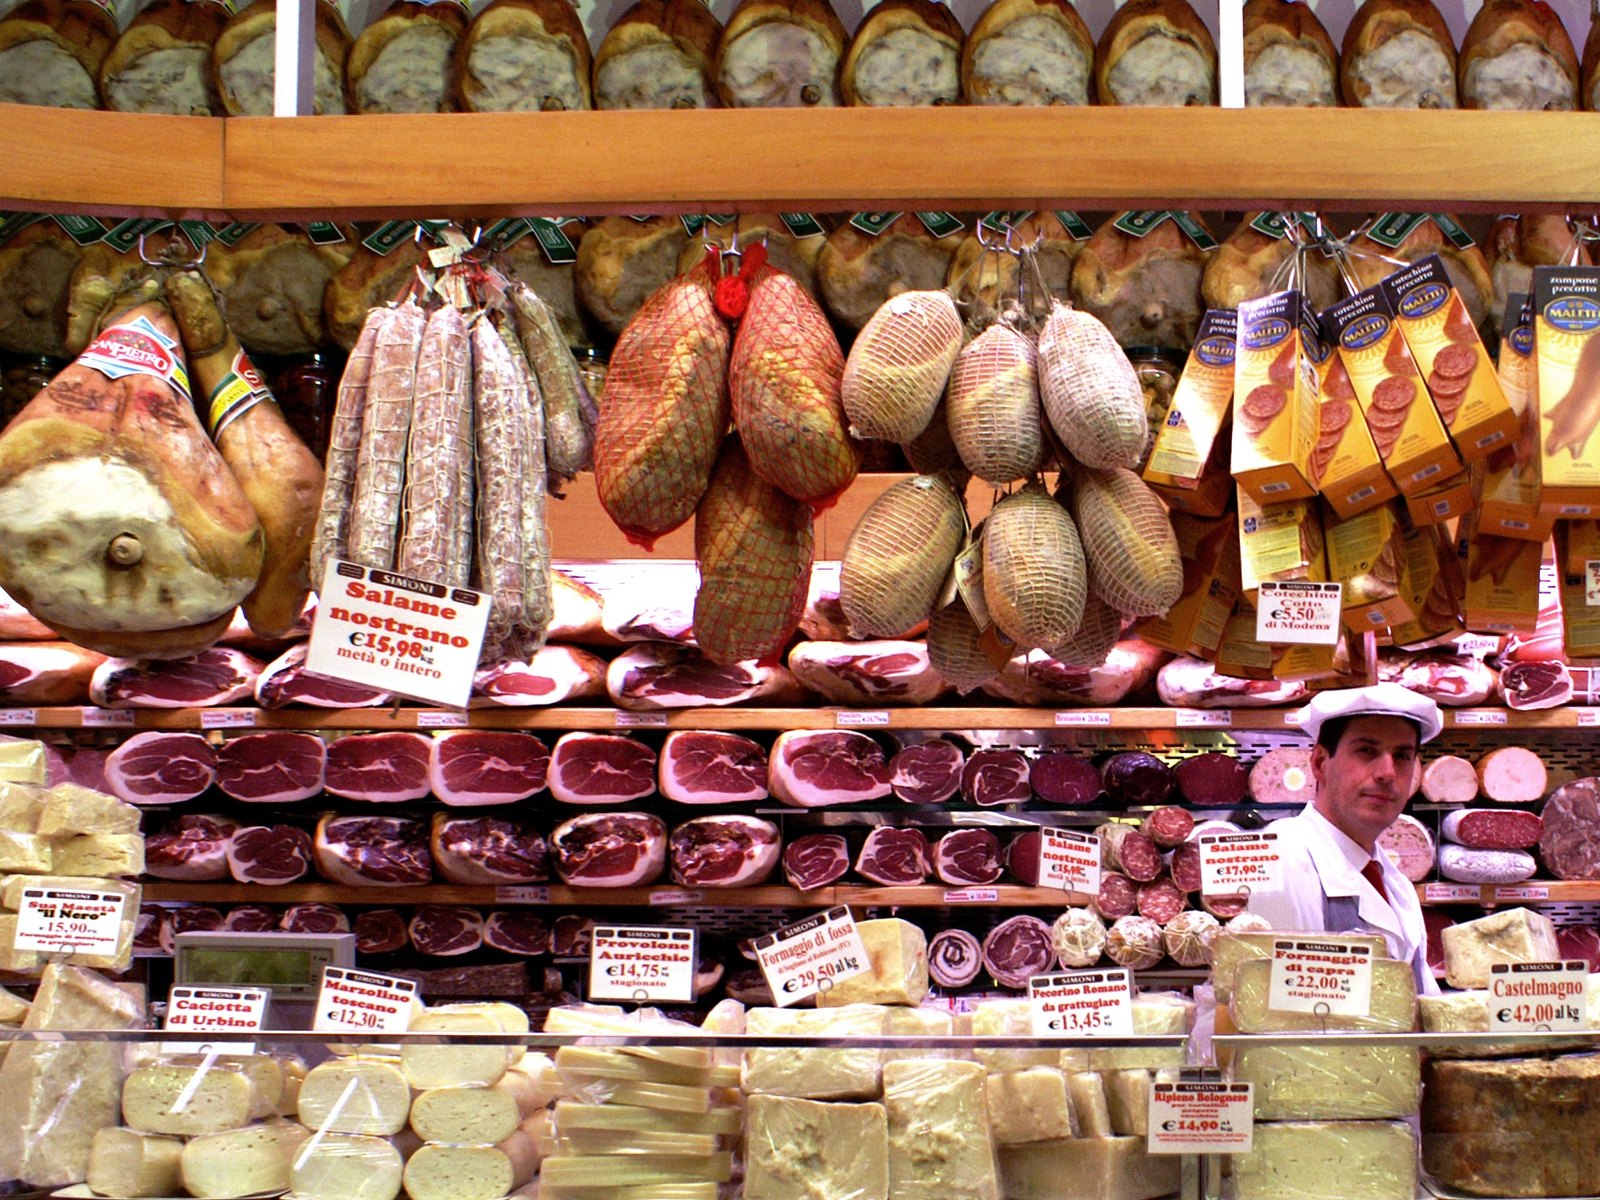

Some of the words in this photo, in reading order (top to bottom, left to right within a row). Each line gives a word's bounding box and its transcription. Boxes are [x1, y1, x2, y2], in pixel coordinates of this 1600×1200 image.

[1390, 263, 1433, 288] cotechino
[1396, 270, 1434, 295] precotto
[1550, 277, 1599, 287] zampone
[1552, 285, 1597, 295] precotto
[1333, 293, 1375, 318] cotechino
[1403, 287, 1445, 312] MALETTI
[1338, 301, 1375, 326] precotto
[1211, 317, 1237, 327] cotech
[1344, 319, 1386, 342] MALETTI
[383, 574, 434, 594] SIMONI
[346, 581, 457, 620] Salame
[1261, 589, 1338, 599] Cotechino
[1280, 599, 1322, 607] Cotto
[1270, 607, 1314, 621] €5,50
[329, 607, 469, 649] nostrano
[1265, 621, 1277, 629] di
[1281, 622, 1331, 630] Modena
[349, 632, 423, 658] €15,98
[422, 645, 433, 653] al
[337, 647, 376, 664] metà
[380, 657, 390, 667] o
[394, 658, 442, 680] intero
[420, 654, 434, 665] kg
[1048, 838, 1091, 853] Salame
[1210, 843, 1269, 852] Salame
[1043, 852, 1098, 867] nostrano
[1205, 855, 1279, 865] nostrano
[1212, 876, 1270, 884] affettato
[28, 901, 57, 909] Sua
[61, 903, 117, 913] Maestà
[626, 931, 661, 939] SIMONI
[784, 919, 819, 938] SIMONI
[595, 939, 690, 950] Provolone
[761, 938, 814, 968] Formaggio
[815, 930, 826, 947] di
[828, 923, 853, 941] fossa
[598, 951, 690, 962] Auricchio
[844, 956, 860, 970] kg
[1275, 950, 1368, 965] Formaggio
[605, 963, 659, 978] €14,75
[1285, 964, 1302, 972] di
[1306, 966, 1356, 976] capra
[354, 975, 386, 985] SIMONI
[610, 979, 667, 988] stagionato
[1061, 976, 1095, 984] SIMONI
[325, 979, 410, 1003] Marzolino
[1032, 987, 1081, 999] Pecorino
[1083, 983, 1127, 994] Romano
[1288, 990, 1346, 1000] stagionato
[1493, 978, 1583, 1000] Castelmagno
[176, 1000, 252, 1012] Caciotta
[332, 996, 397, 1014] toscano
[1042, 1003, 1055, 1012] da
[1057, 998, 1120, 1013] grattugiare
[170, 1015, 187, 1024] di
[193, 1015, 257, 1027] Urbino
[1555, 1005, 1564, 1019] al
[1566, 1005, 1580, 1023] kg
[1154, 1092, 1195, 1104] Ripieno
[1197, 1092, 1249, 1104] Bolognese
